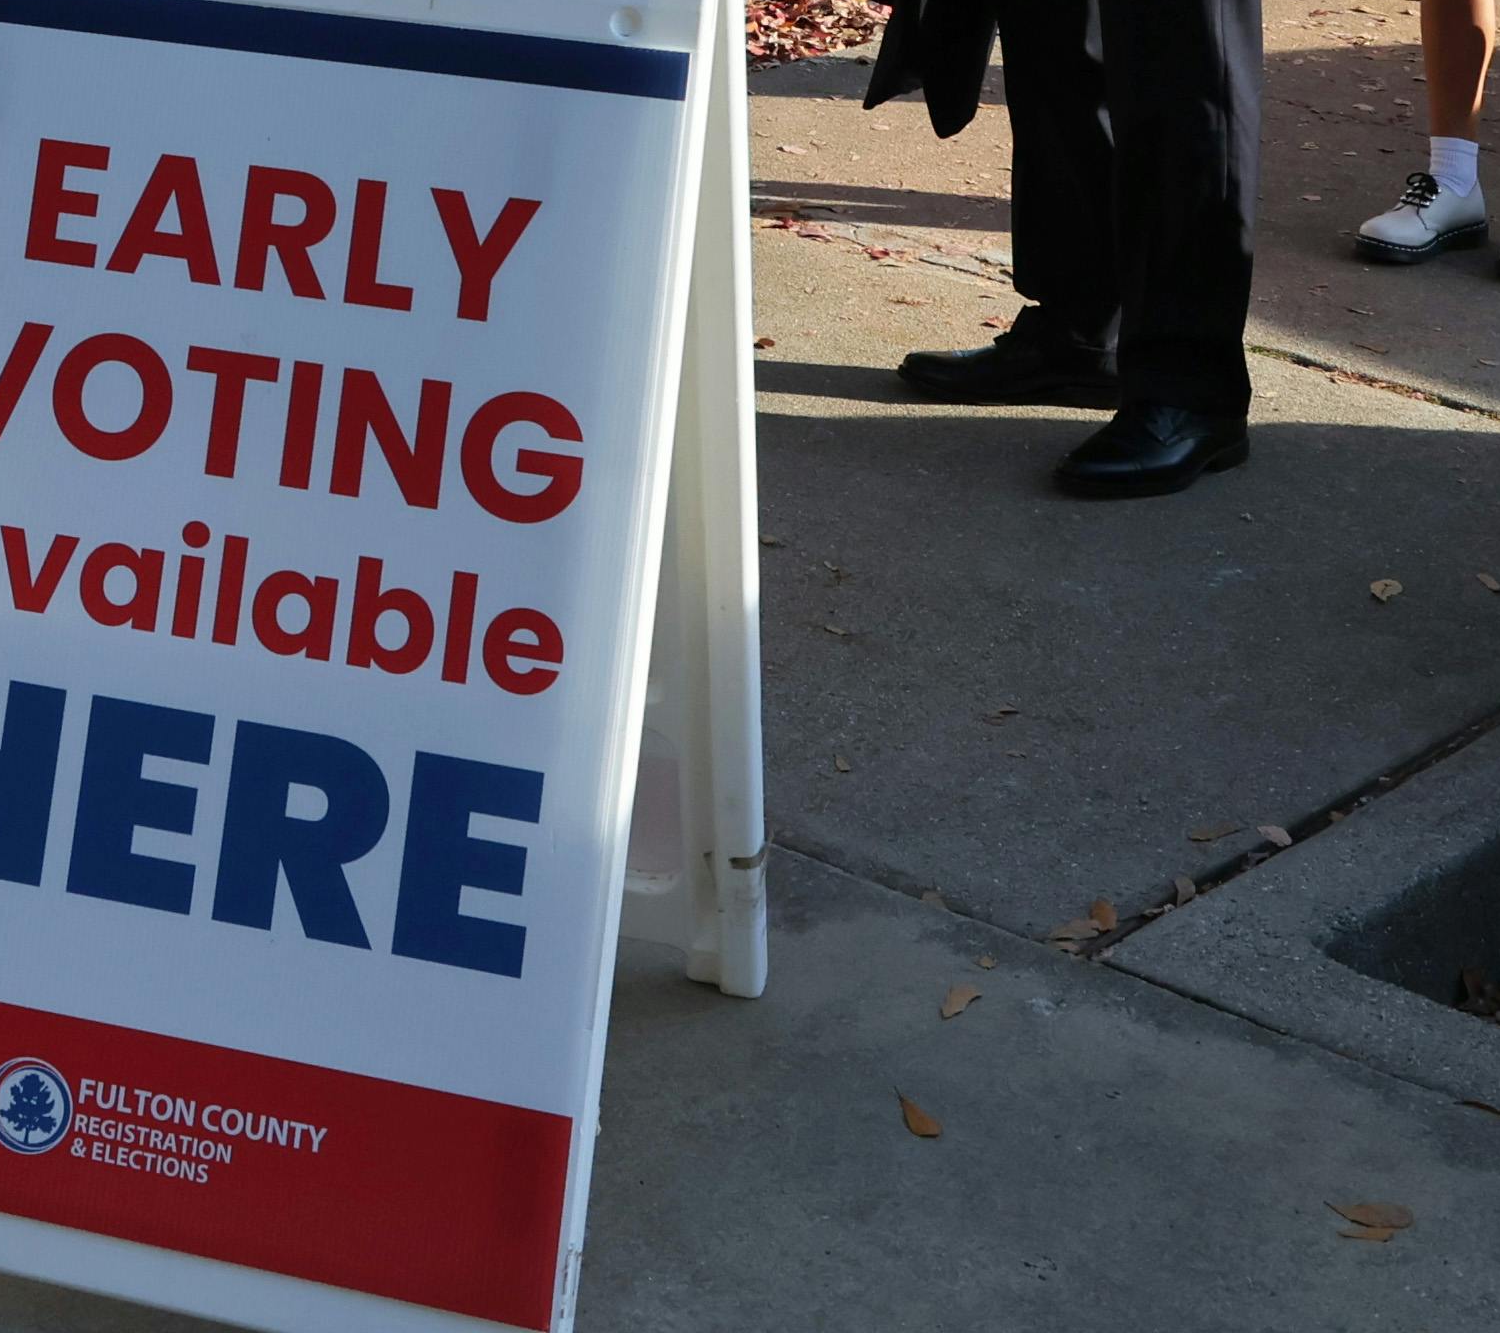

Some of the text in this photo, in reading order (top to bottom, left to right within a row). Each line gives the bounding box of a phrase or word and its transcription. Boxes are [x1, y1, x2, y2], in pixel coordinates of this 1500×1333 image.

[27, 139, 541, 321] EARLY
[73, 1113, 233, 1164] REGISTRATION
[77, 1077, 329, 1154] FULTON COUNTY
[70, 1137, 210, 1185] & ELECTIONS
